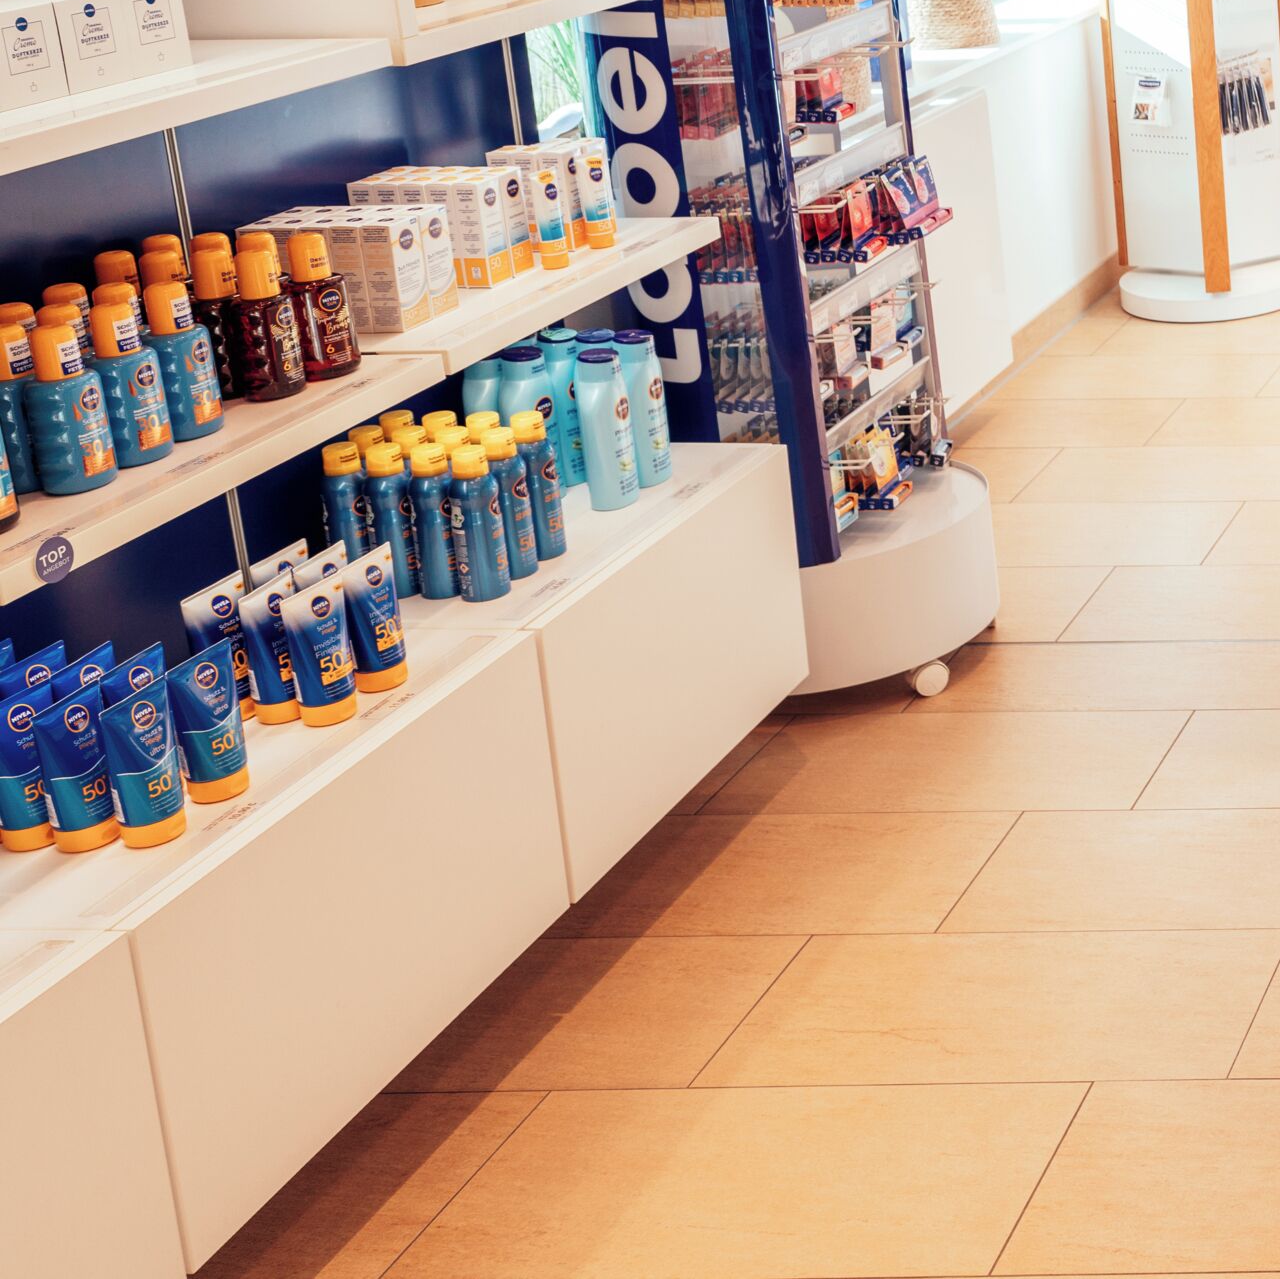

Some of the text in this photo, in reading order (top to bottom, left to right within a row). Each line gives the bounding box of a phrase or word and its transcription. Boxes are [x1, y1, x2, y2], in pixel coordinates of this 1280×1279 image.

[322, 295, 340, 304] NIVEA
[326, 344, 335, 354] 6
[137, 414, 159, 432] 30
[81, 439, 104, 457] 30
[39, 543, 70, 568] TOP
[41, 554, 72, 579] ANGEBOT
[198, 667, 215, 680] NIVEA
[135, 707, 153, 720] NIVEA
[213, 703, 229, 716] ultra
[11, 710, 32, 724] NIVEA
[68, 710, 86, 724] NIVEA
[149, 744, 166, 757] ultra
